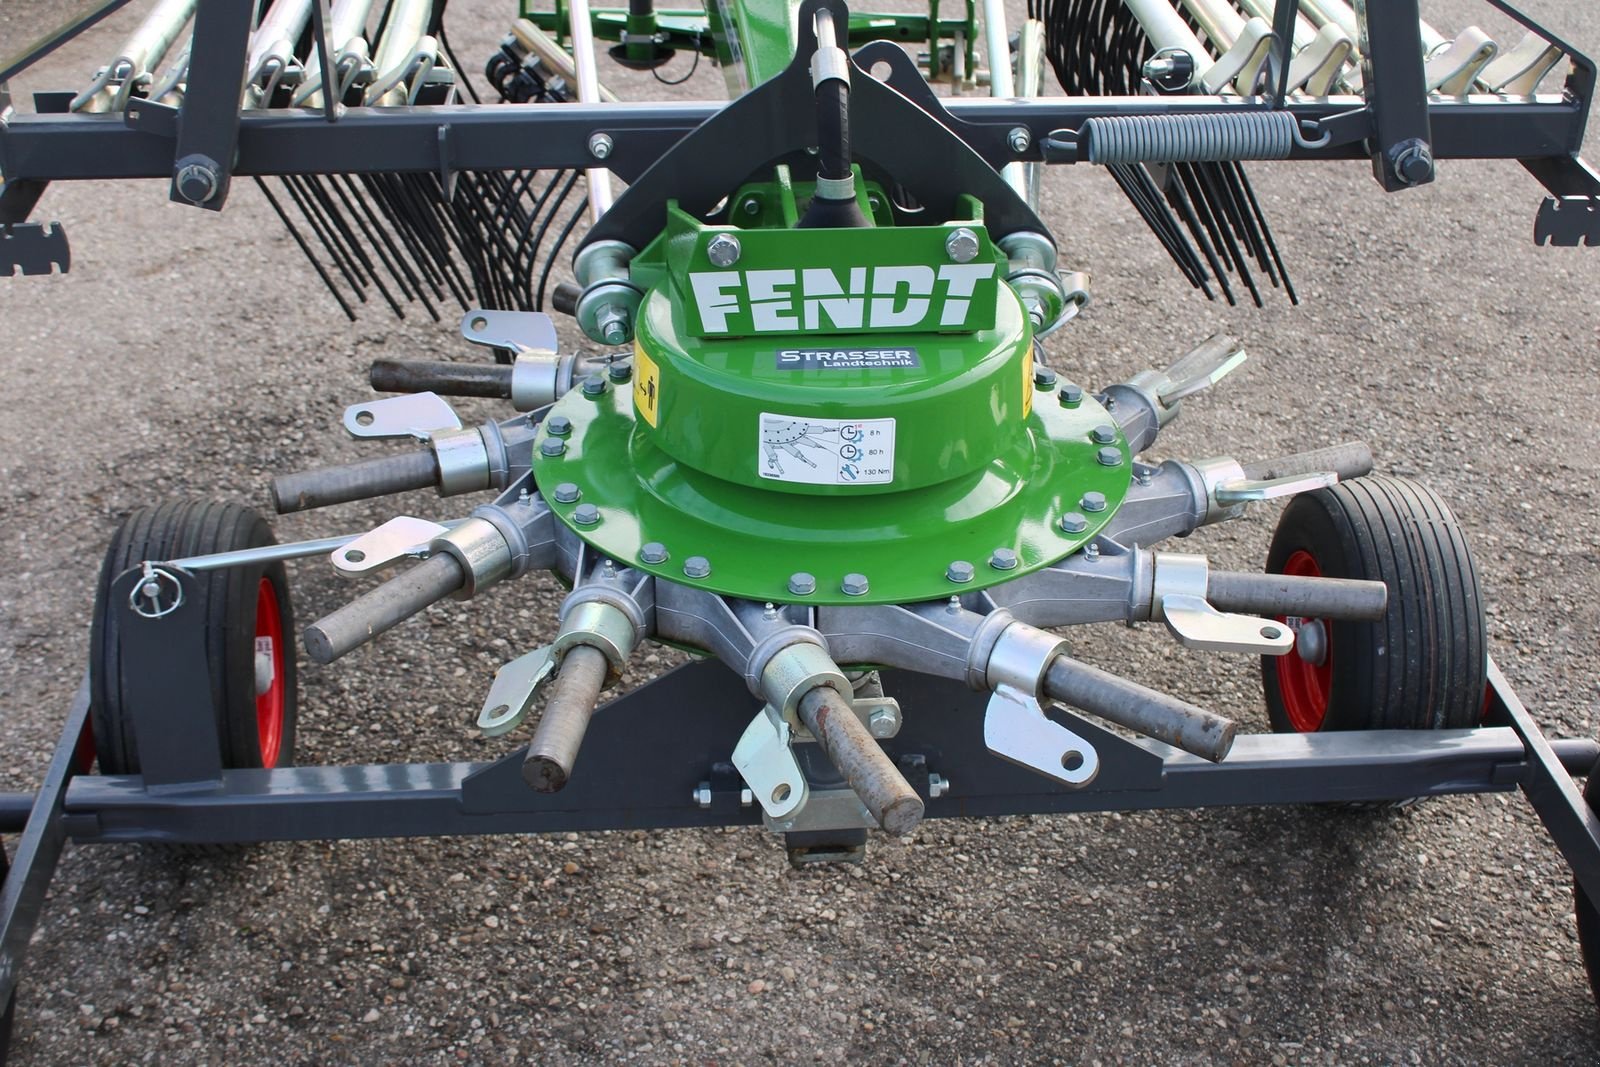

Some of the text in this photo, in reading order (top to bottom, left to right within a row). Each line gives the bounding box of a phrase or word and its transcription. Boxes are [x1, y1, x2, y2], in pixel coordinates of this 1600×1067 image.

[689, 263, 997, 333] FENDT
[781, 350, 911, 362] STRASSER
[824, 359, 914, 367] Landtechnik
